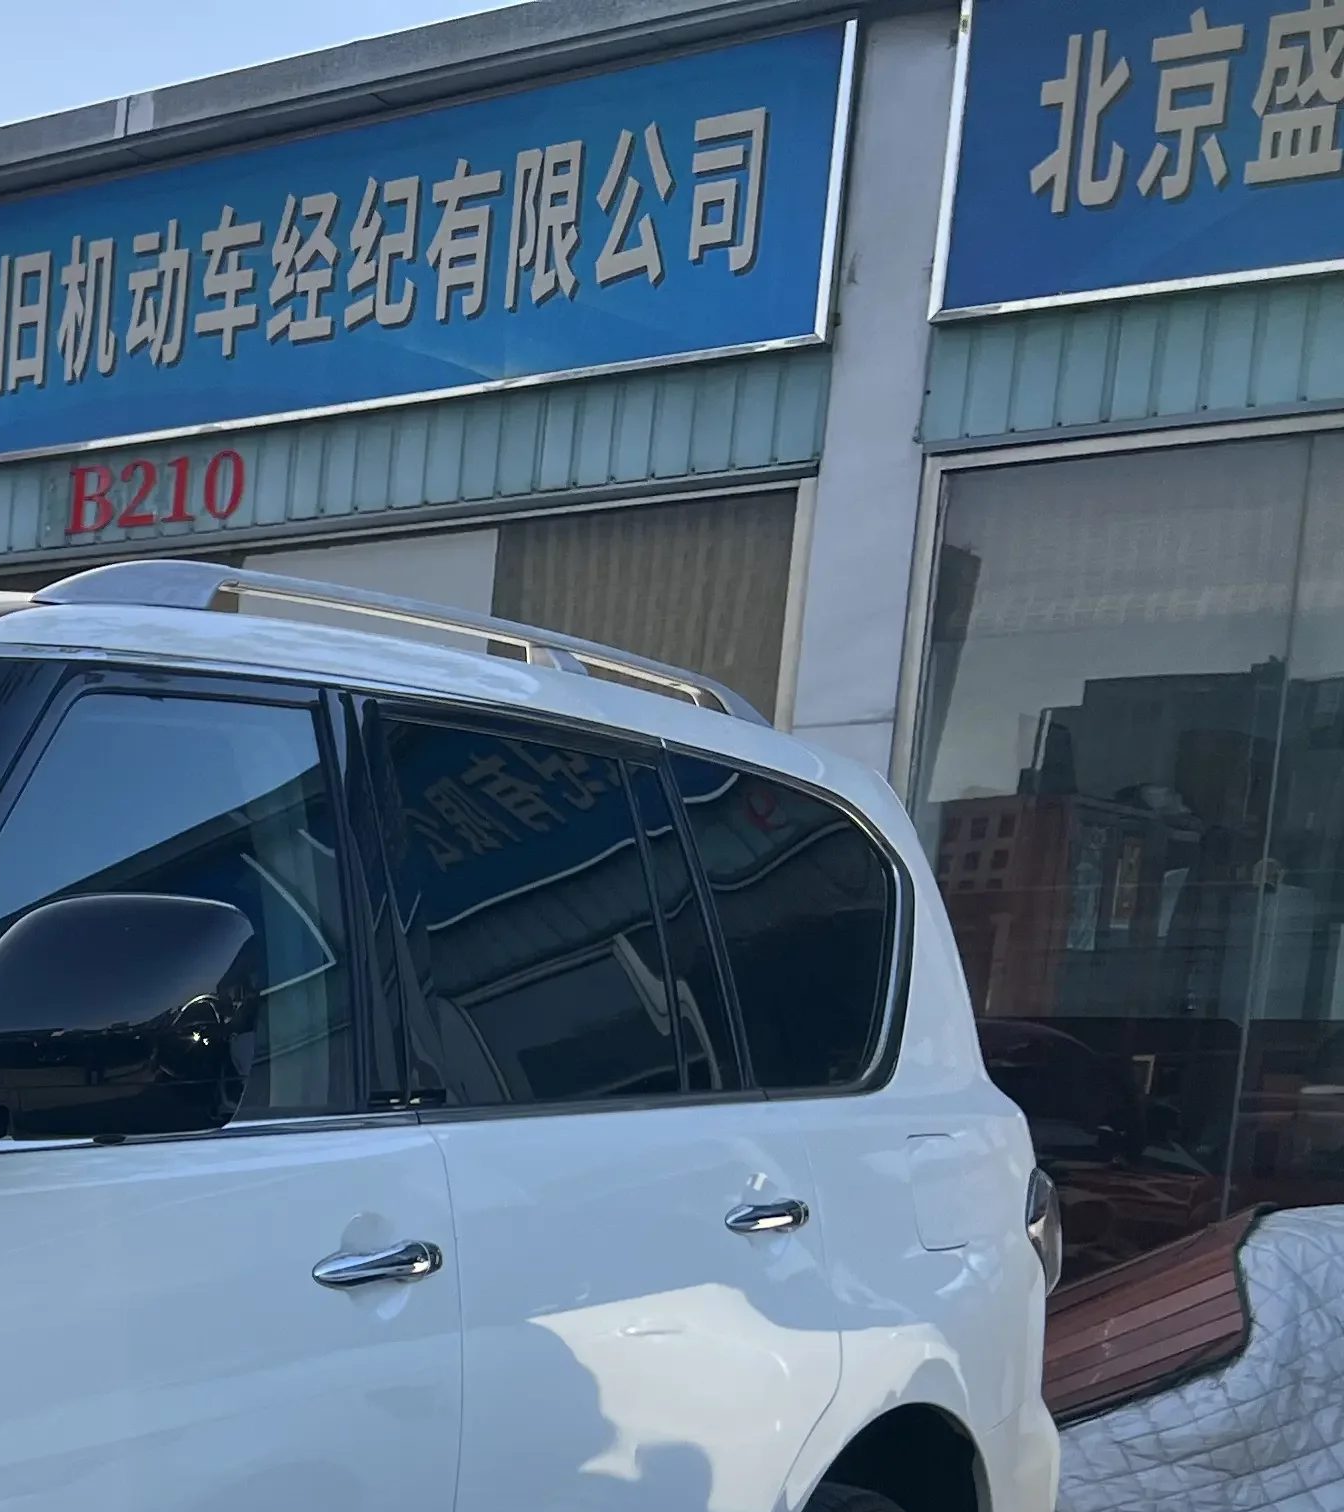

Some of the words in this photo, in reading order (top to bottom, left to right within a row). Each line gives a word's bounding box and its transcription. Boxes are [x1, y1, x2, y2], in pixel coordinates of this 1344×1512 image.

[1029, 0, 1344, 216] 北京盛
[64, 449, 246, 538] B210
